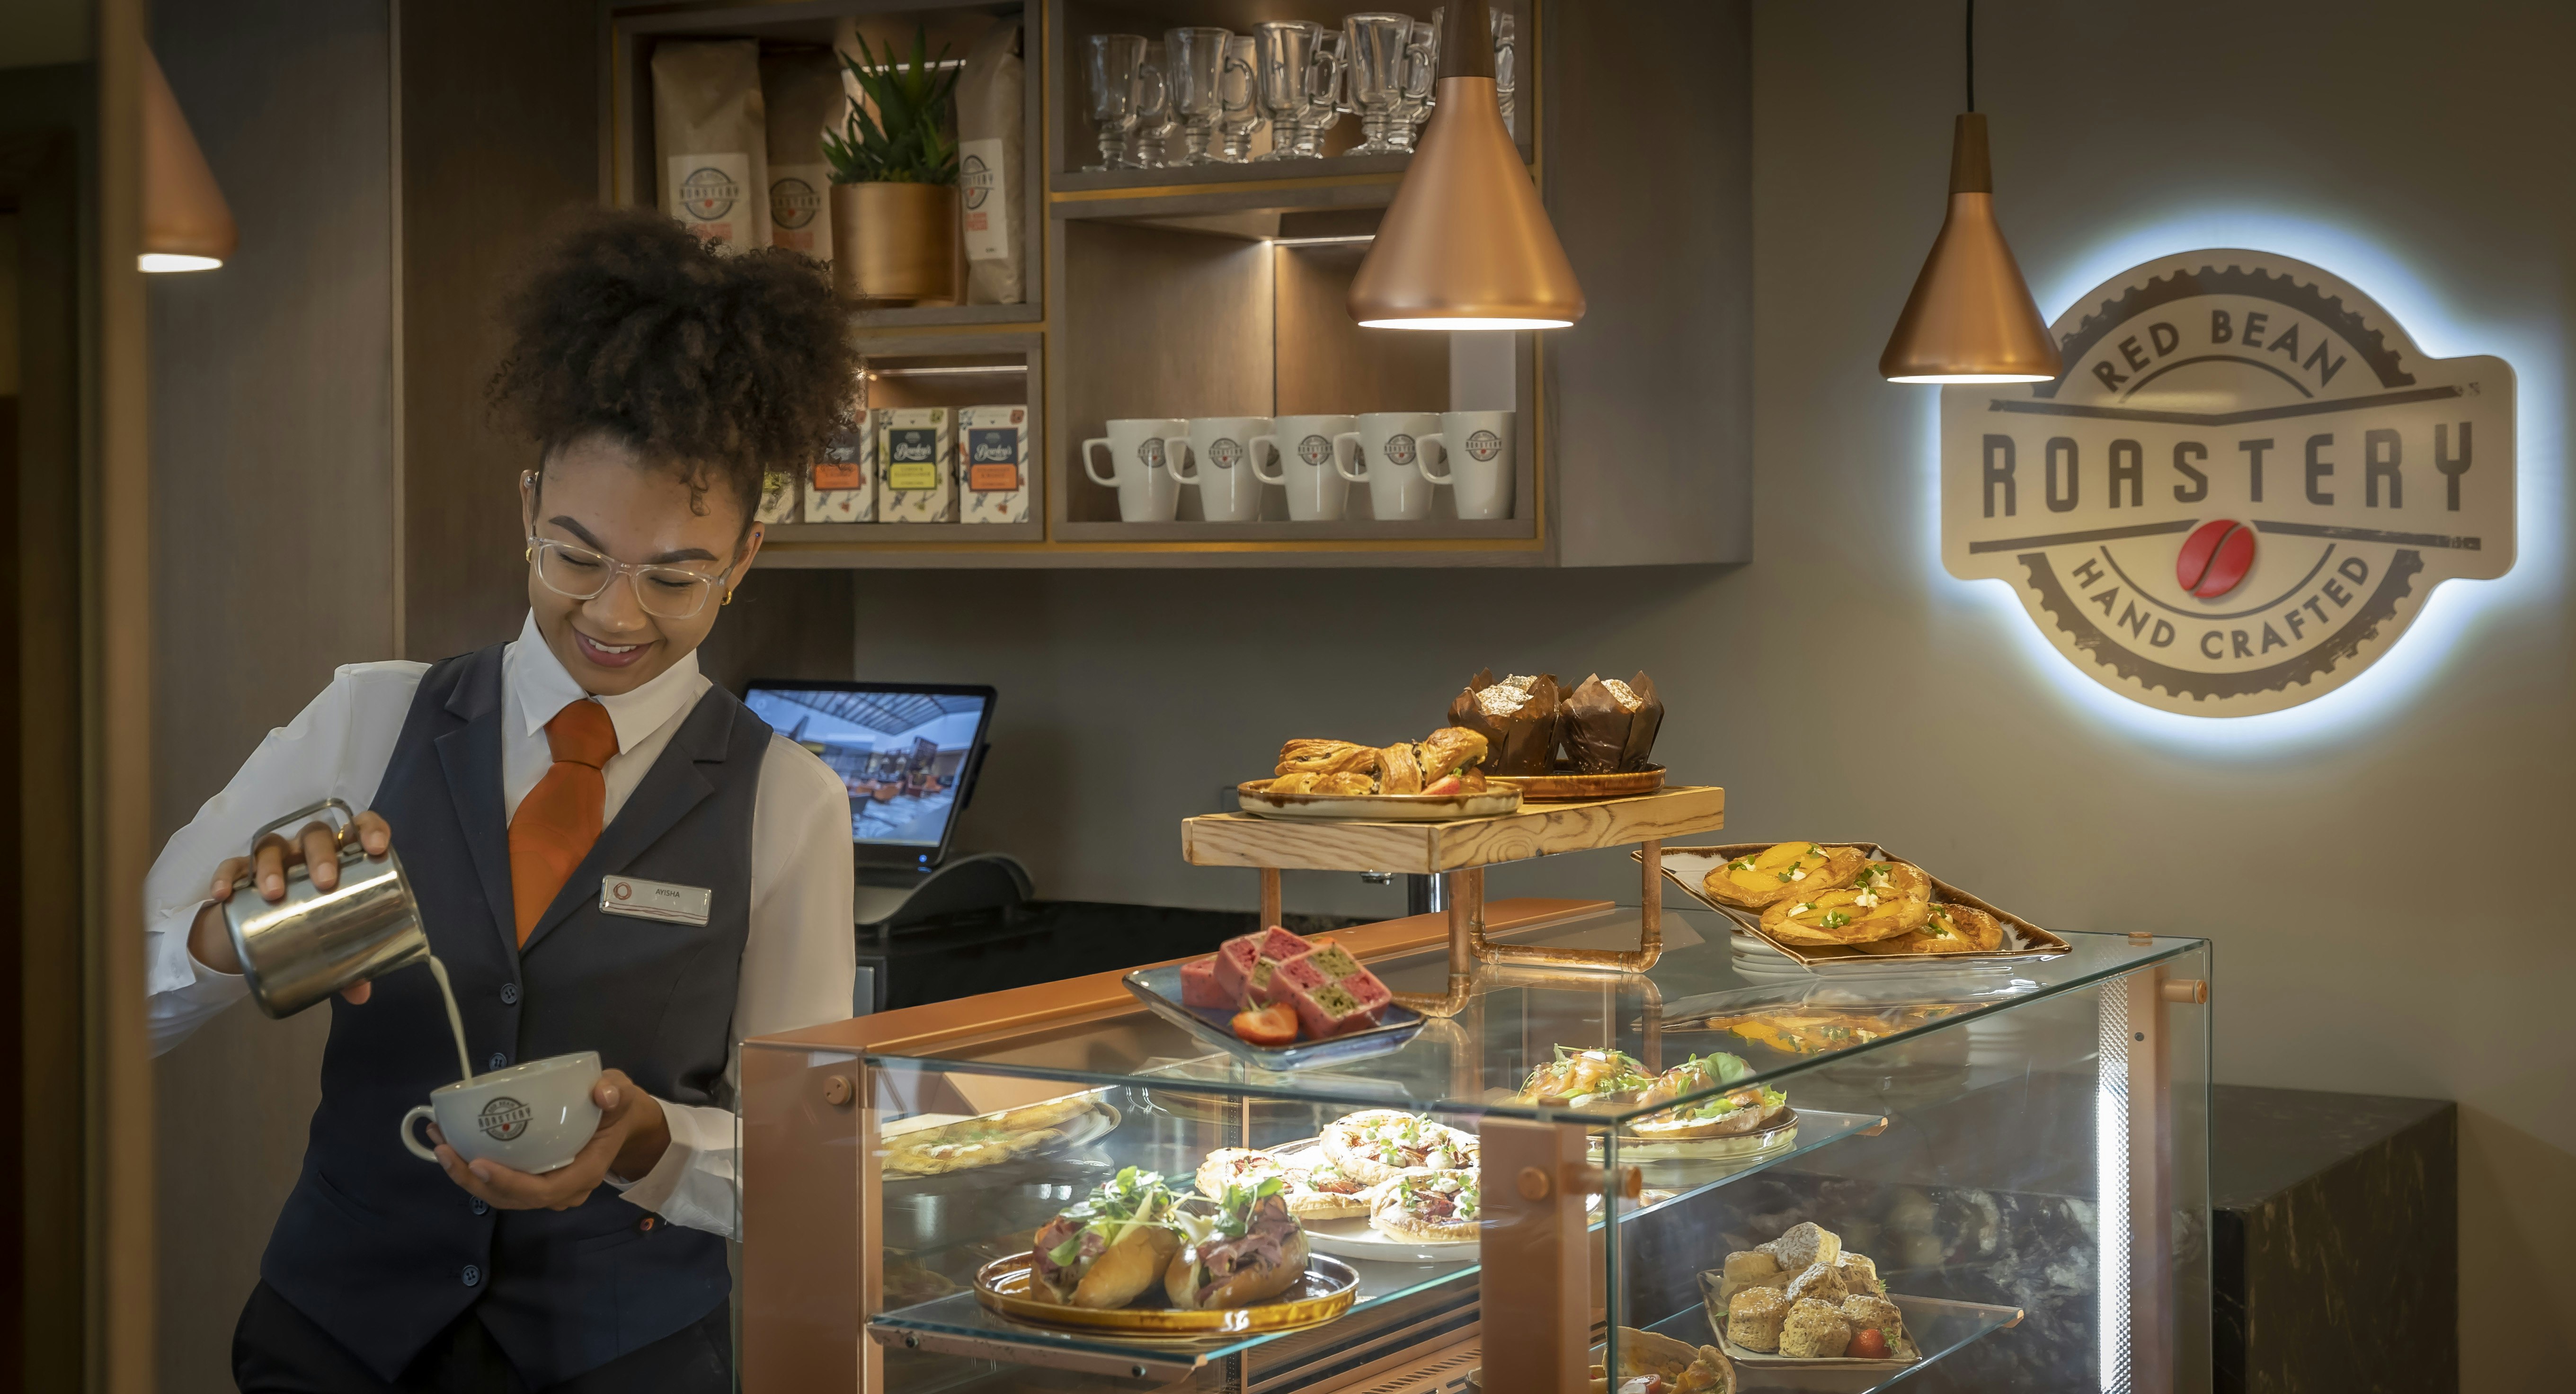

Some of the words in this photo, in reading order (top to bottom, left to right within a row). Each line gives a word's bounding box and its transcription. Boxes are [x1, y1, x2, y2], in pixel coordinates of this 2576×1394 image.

[2091, 322, 2180, 393] RED
[2211, 309, 2347, 388] BEAN
[1982, 420, 2473, 518] ROASTERY
[2071, 557, 2176, 648] HAND
[2200, 556, 2369, 659] CRAFTED
[655, 888, 680, 898] AYISHA
